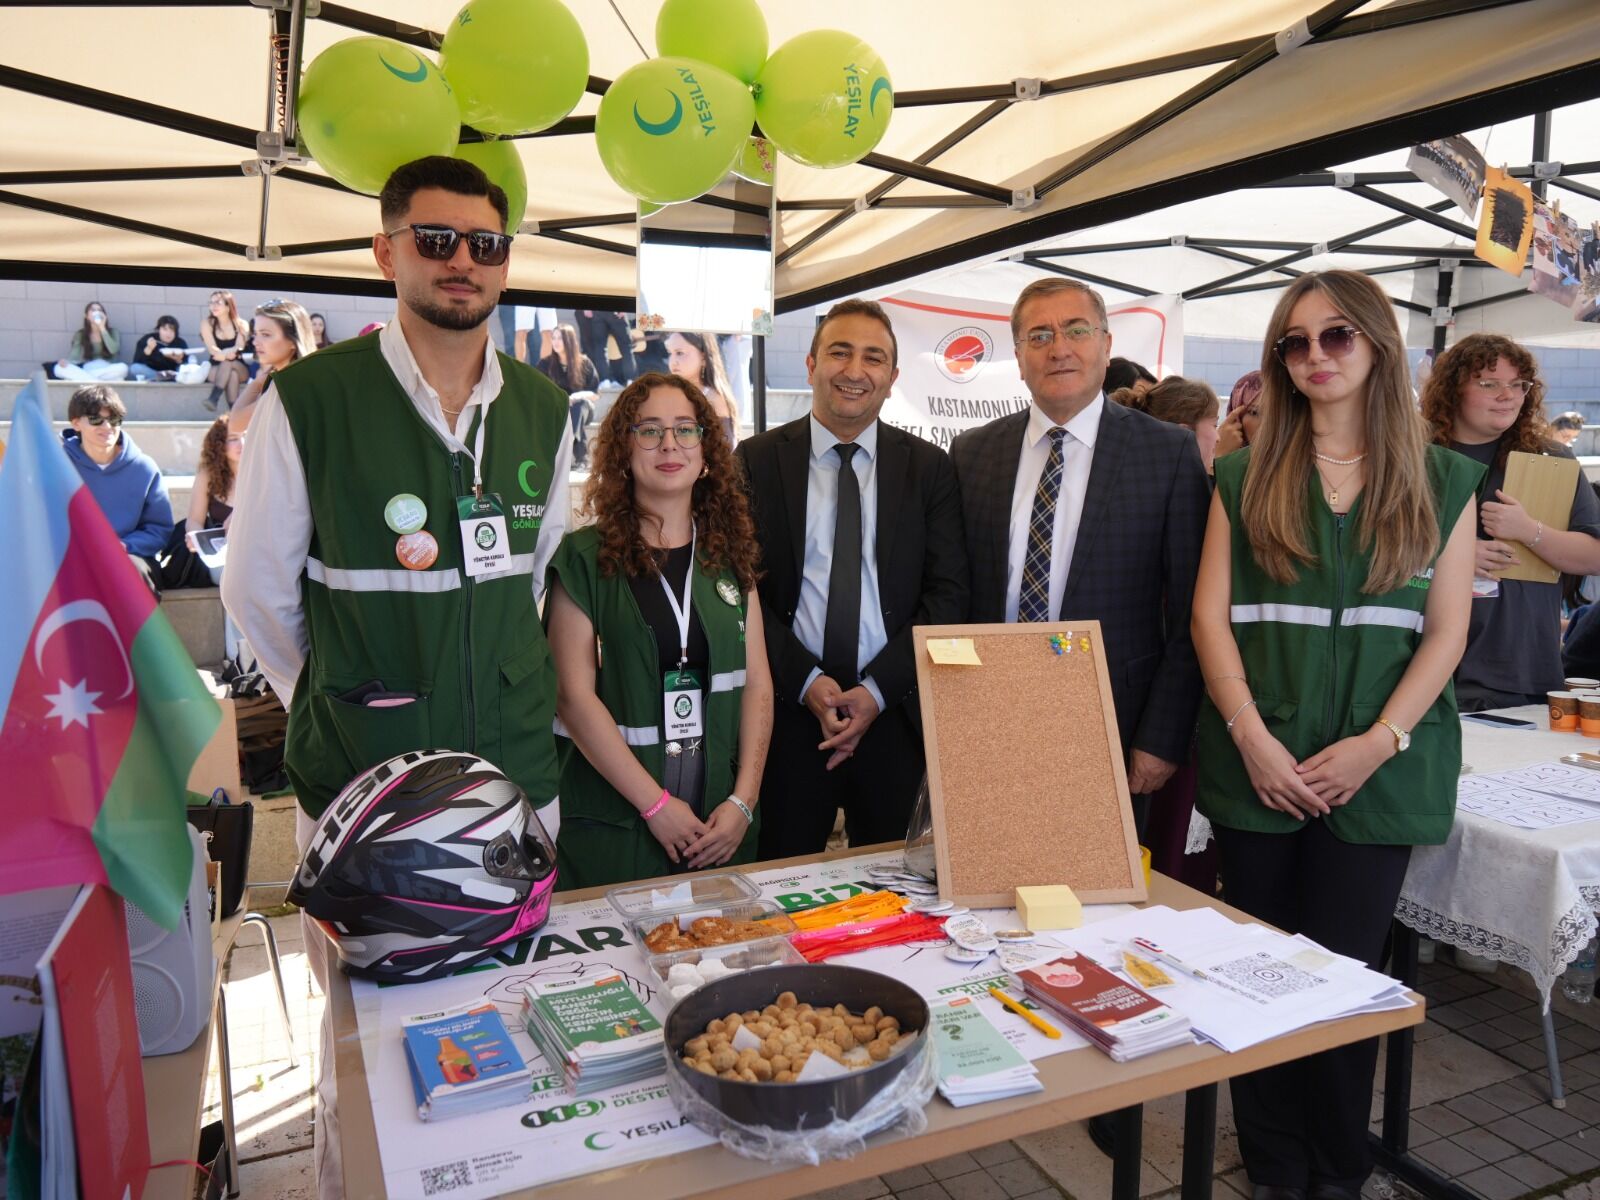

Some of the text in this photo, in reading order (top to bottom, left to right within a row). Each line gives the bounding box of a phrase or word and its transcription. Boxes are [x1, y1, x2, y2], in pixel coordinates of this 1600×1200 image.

[927, 395, 1012, 420] KASTAMONU
[492, 926, 633, 966] VAR
[569, 1025, 597, 1034] ARA
[528, 1102, 592, 1127] 115
